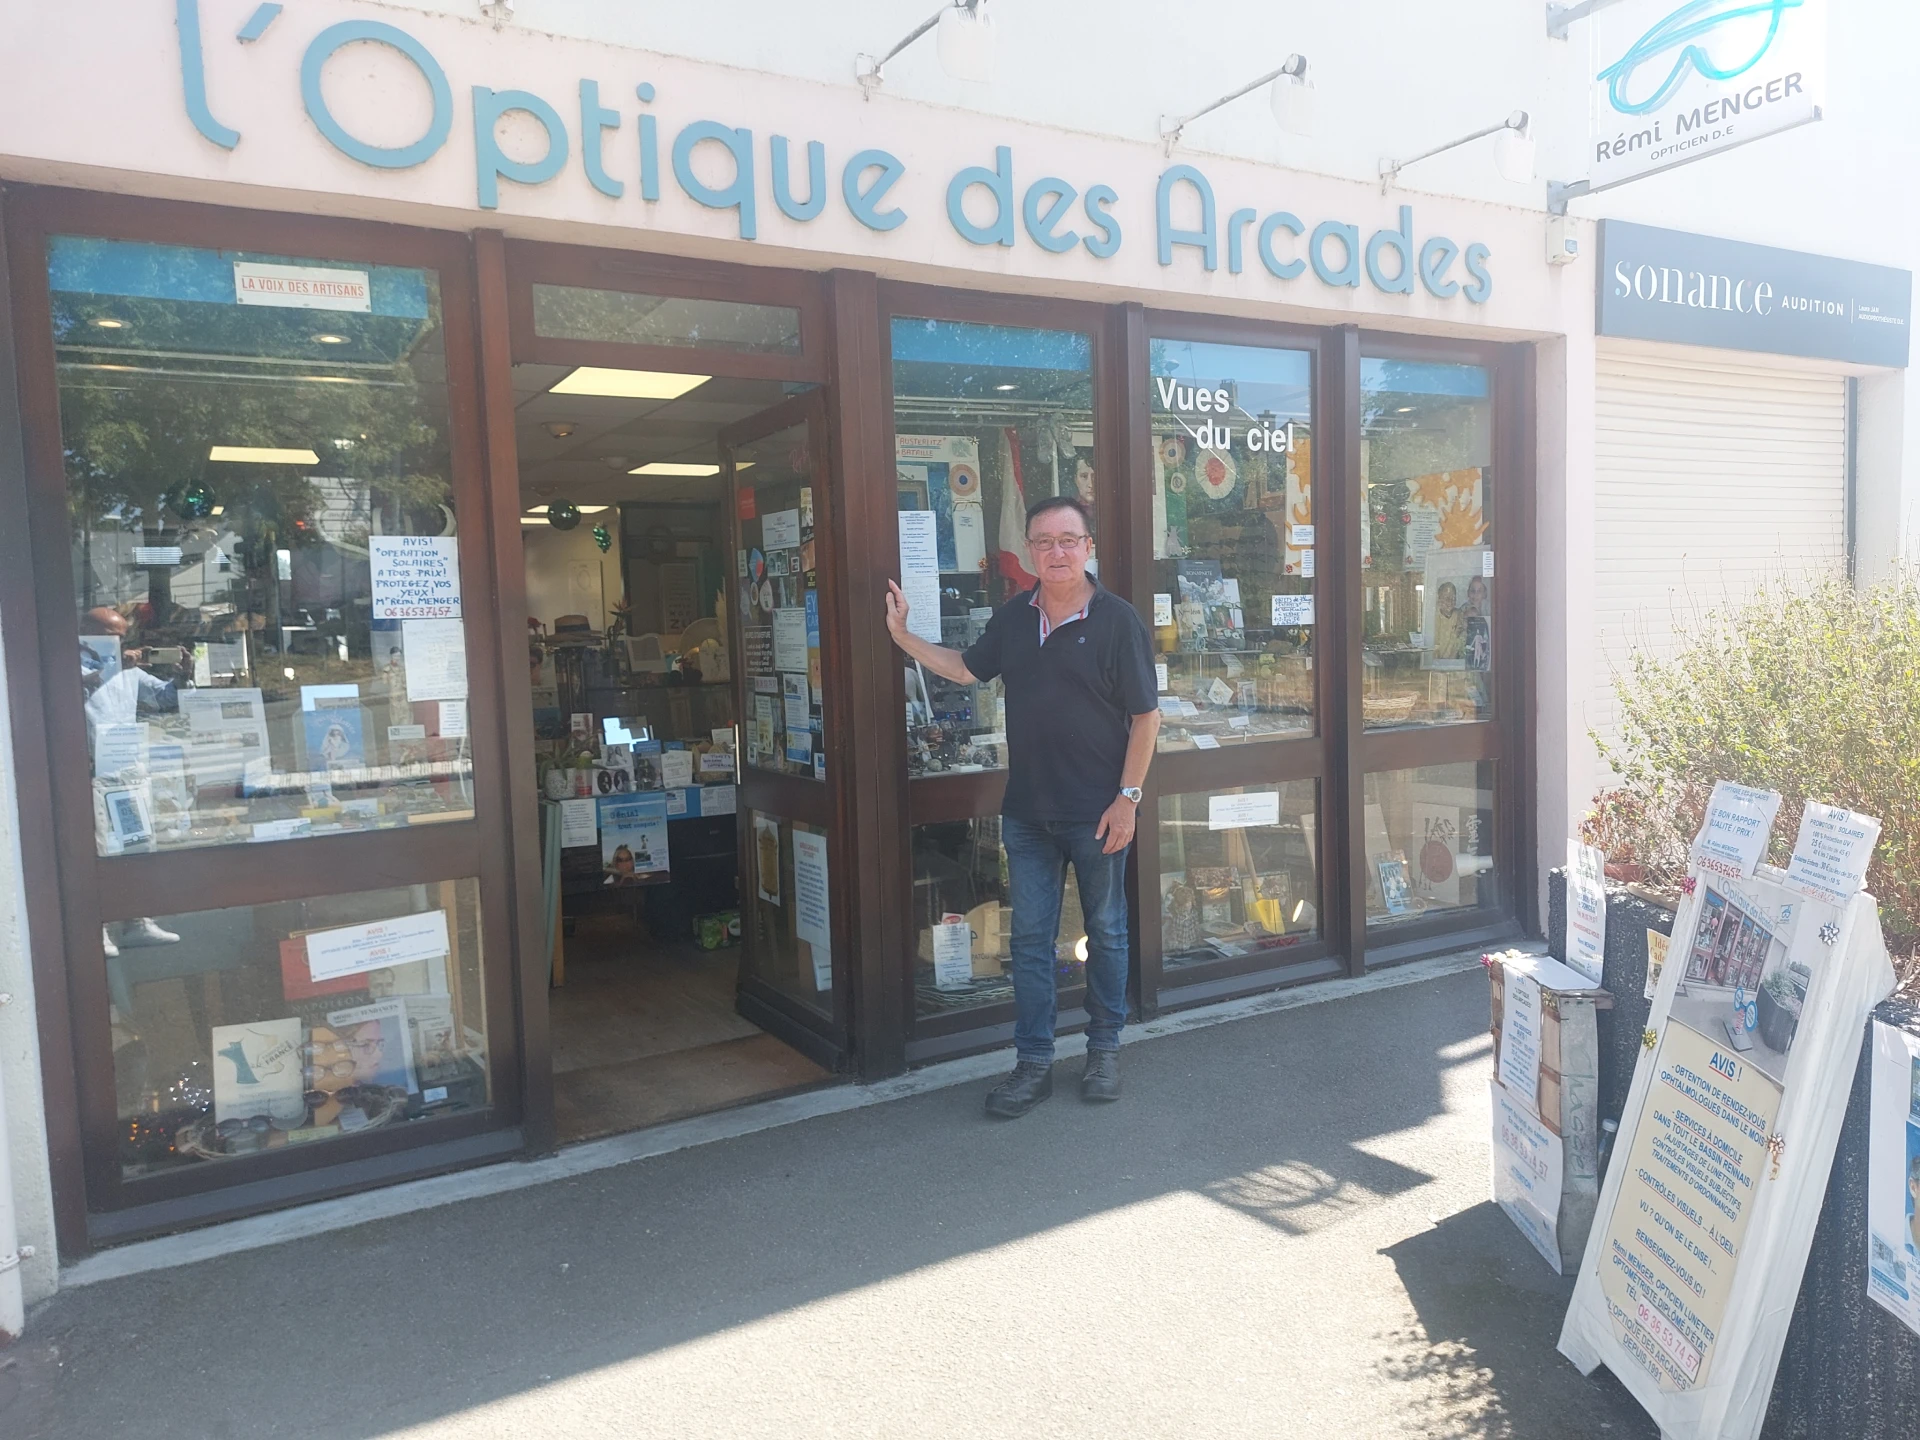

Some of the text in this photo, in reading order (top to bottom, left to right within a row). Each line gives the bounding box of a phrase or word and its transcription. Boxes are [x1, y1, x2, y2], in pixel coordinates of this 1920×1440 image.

[1596, 72, 1803, 163] Rémi MENGER
[176, 0, 1493, 303] l'Optique des Arcades
[1650, 133, 1709, 161] OPTICIEN
[241, 277, 365, 297] LA VOIX DES ARTISANS
[1614, 259, 1844, 316] sonance AUDITION
[1155, 376, 1231, 414] Vues
[1196, 417, 1294, 454] du ciel
[378, 569, 384, 577] A
[387, 569, 411, 577] TOUS
[434, 580, 452, 588] VOS
[384, 606, 452, 619] 0636537457
[417, 596, 461, 605] MENGER
[1718, 809, 1731, 819] BON
[1731, 813, 1761, 829] RAPPORT
[1736, 826, 1751, 837] PRIX
[1827, 809, 1846, 822] AVIS
[1837, 826, 1865, 839] SOLAIRES
[1709, 1052, 1736, 1078] AVIS
[1660, 1070, 1766, 1147] OPHTALMOLOGUES DANS LE MOIS
[1674, 1064, 1767, 1131] OBTENTION DE RENDEZ-VOUS
[1653, 1110, 1671, 1128] DANS
[1672, 1122, 1690, 1141] TOUT
[1689, 1135, 1699, 1148] LE
[1698, 1141, 1723, 1166] BASSIN
[1722, 1159, 1751, 1188] RENNAIS
[1675, 1109, 1744, 1165] SERVICES À DOMICILE
[1538, 1160, 1549, 1178] 57
[1651, 1148, 1738, 1223] TRAITEMENTS D'ORDONNANCES)
[1663, 1132, 1736, 1192] (AJUSTAGES DE LUNETTES,
[1686, 1159, 1709, 1183] VISUELS
[1708, 1178, 1742, 1212] SUBJECTIFS,
[1638, 1168, 1676, 1203] CONTRÔLES
[1676, 1197, 1703, 1226] VISUELS
[1715, 1231, 1734, 1255] L'OEIL
[1639, 1199, 1649, 1213] VU
[1654, 1212, 1675, 1236] QU'ON
[1674, 1229, 1684, 1244] SE
[1684, 1237, 1693, 1252] LE
[1692, 1246, 1709, 1266] DISE
[1635, 1228, 1694, 1287] RENSEIGNEZ-VOUS
[1693, 1281, 1703, 1295] ICI
[1612, 1238, 1628, 1258] Rémi
[1655, 1279, 1685, 1312] OPTICIEN
[1684, 1307, 1715, 1345] LUNETIER
[1612, 1254, 1708, 1354] OPTOMÉTRISTE DIPLÔMÉ D'ÉTAT
[1625, 1282, 1637, 1302] TÉL
[1622, 1333, 1663, 1382] DEPUIS 1991
[1637, 1303, 1699, 1373] 06 36 53 74 57
[1641, 1333, 1655, 1354] DES
